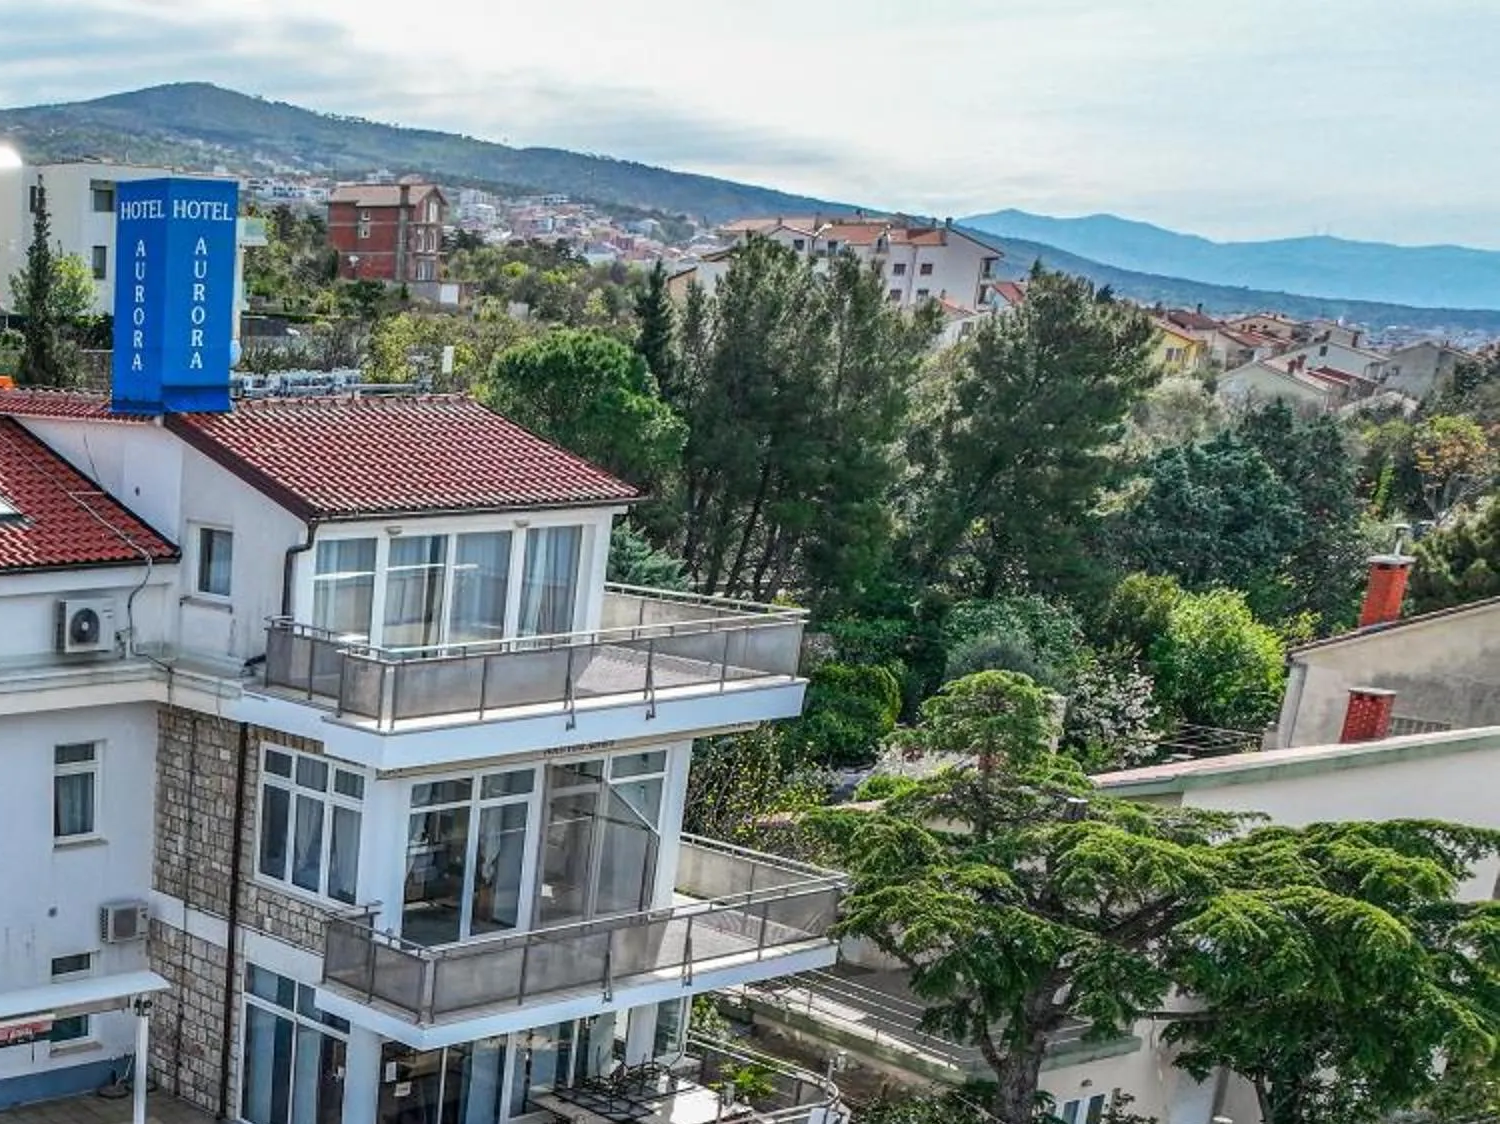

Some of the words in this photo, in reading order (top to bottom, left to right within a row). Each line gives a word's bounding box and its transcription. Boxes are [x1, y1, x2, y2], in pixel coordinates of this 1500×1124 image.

[120, 199, 166, 221] HOTEL
[172, 199, 233, 221] HOTEL
[131, 238, 147, 371] AURORA
[189, 236, 208, 370] AURORA
